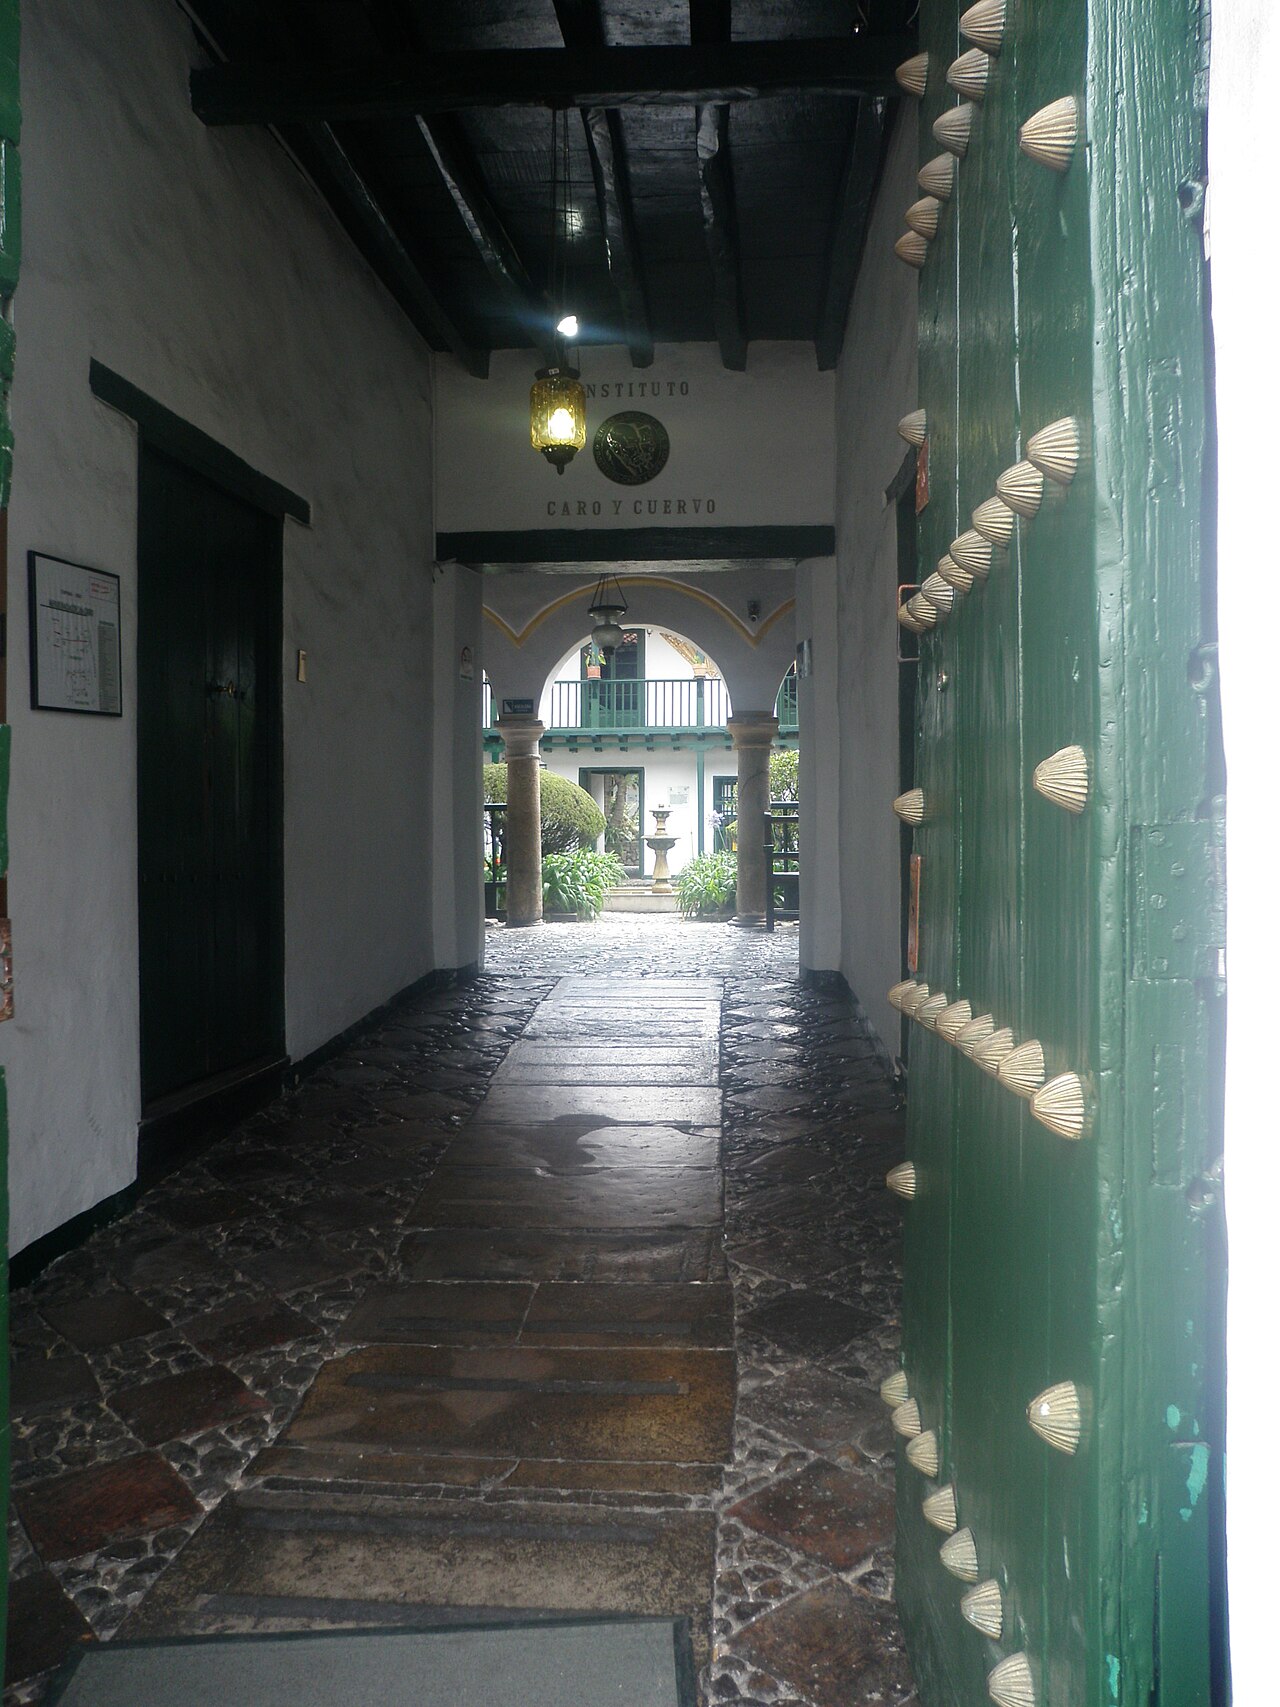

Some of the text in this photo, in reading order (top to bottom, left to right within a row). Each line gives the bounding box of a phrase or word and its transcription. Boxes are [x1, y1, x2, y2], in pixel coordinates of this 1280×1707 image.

[585, 381, 690, 399] NSTITUTO
[546, 498, 717, 517] CARO Y CUERVO
